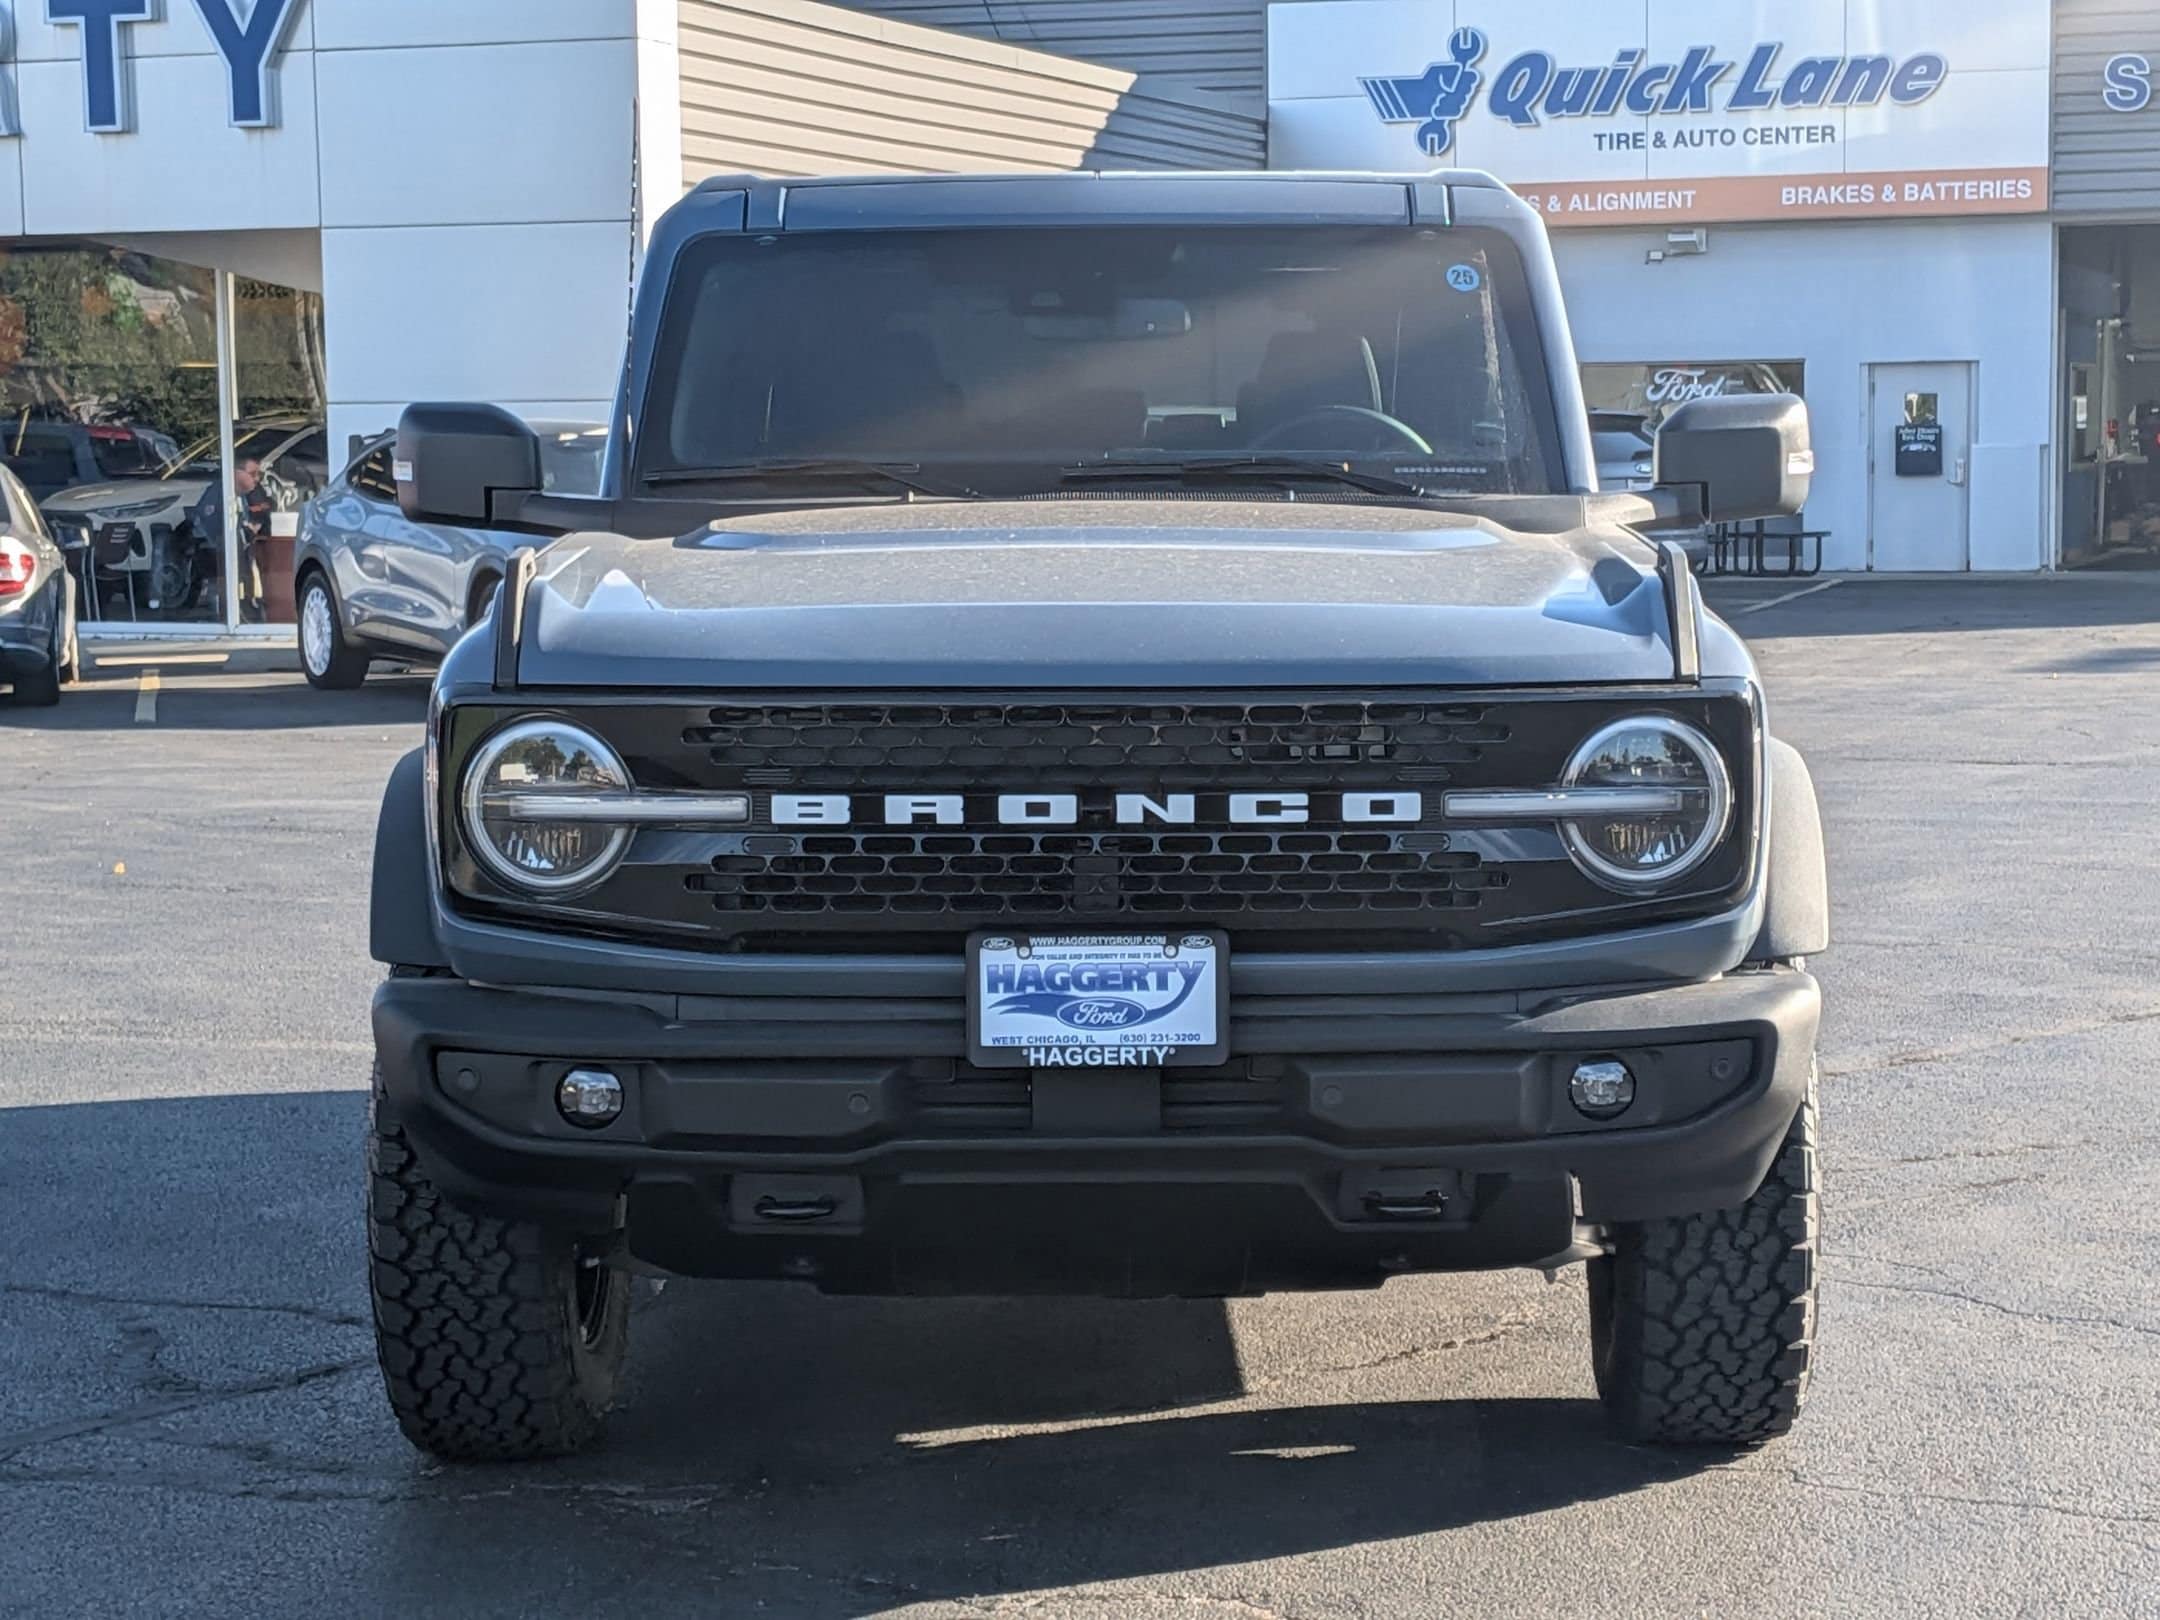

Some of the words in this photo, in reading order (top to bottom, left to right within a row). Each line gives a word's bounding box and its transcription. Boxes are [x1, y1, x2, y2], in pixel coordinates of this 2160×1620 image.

[1488, 45, 1733, 126] Quick
[1723, 40, 1948, 112] Lane
[2103, 53, 2151, 111] S
[1593, 132, 1645, 151] TIRE
[1652, 130, 1667, 149] &
[1673, 128, 1736, 148] AUTO
[1743, 125, 1836, 146] CENTER
[1547, 194, 1562, 213] &
[1568, 189, 1697, 212] ALIGNMENT
[1781, 184, 1875, 205] BRAKES
[1881, 182, 1897, 203] &
[1904, 179, 2032, 202] BATTERIES
[1451, 269, 1474, 286] 25
[1646, 369, 1725, 402] Ford
[771, 793, 1422, 825] BRONCO
[1029, 936, 1167, 946] WWW.HAGGERTYGROUP.COM
[986, 961, 1206, 994] HAGGERTY
[1072, 1001, 1129, 1025] Ford
[992, 1035, 1023, 1045] WEST
[1026, 1034, 1082, 1045] CHICAGO,
[1086, 1034, 1096, 1043] IL
[1120, 1033, 1147, 1043] (630)
[1151, 1033, 1201, 1042] 231-3200
[1029, 1046, 1168, 1066] HAGGERTY
